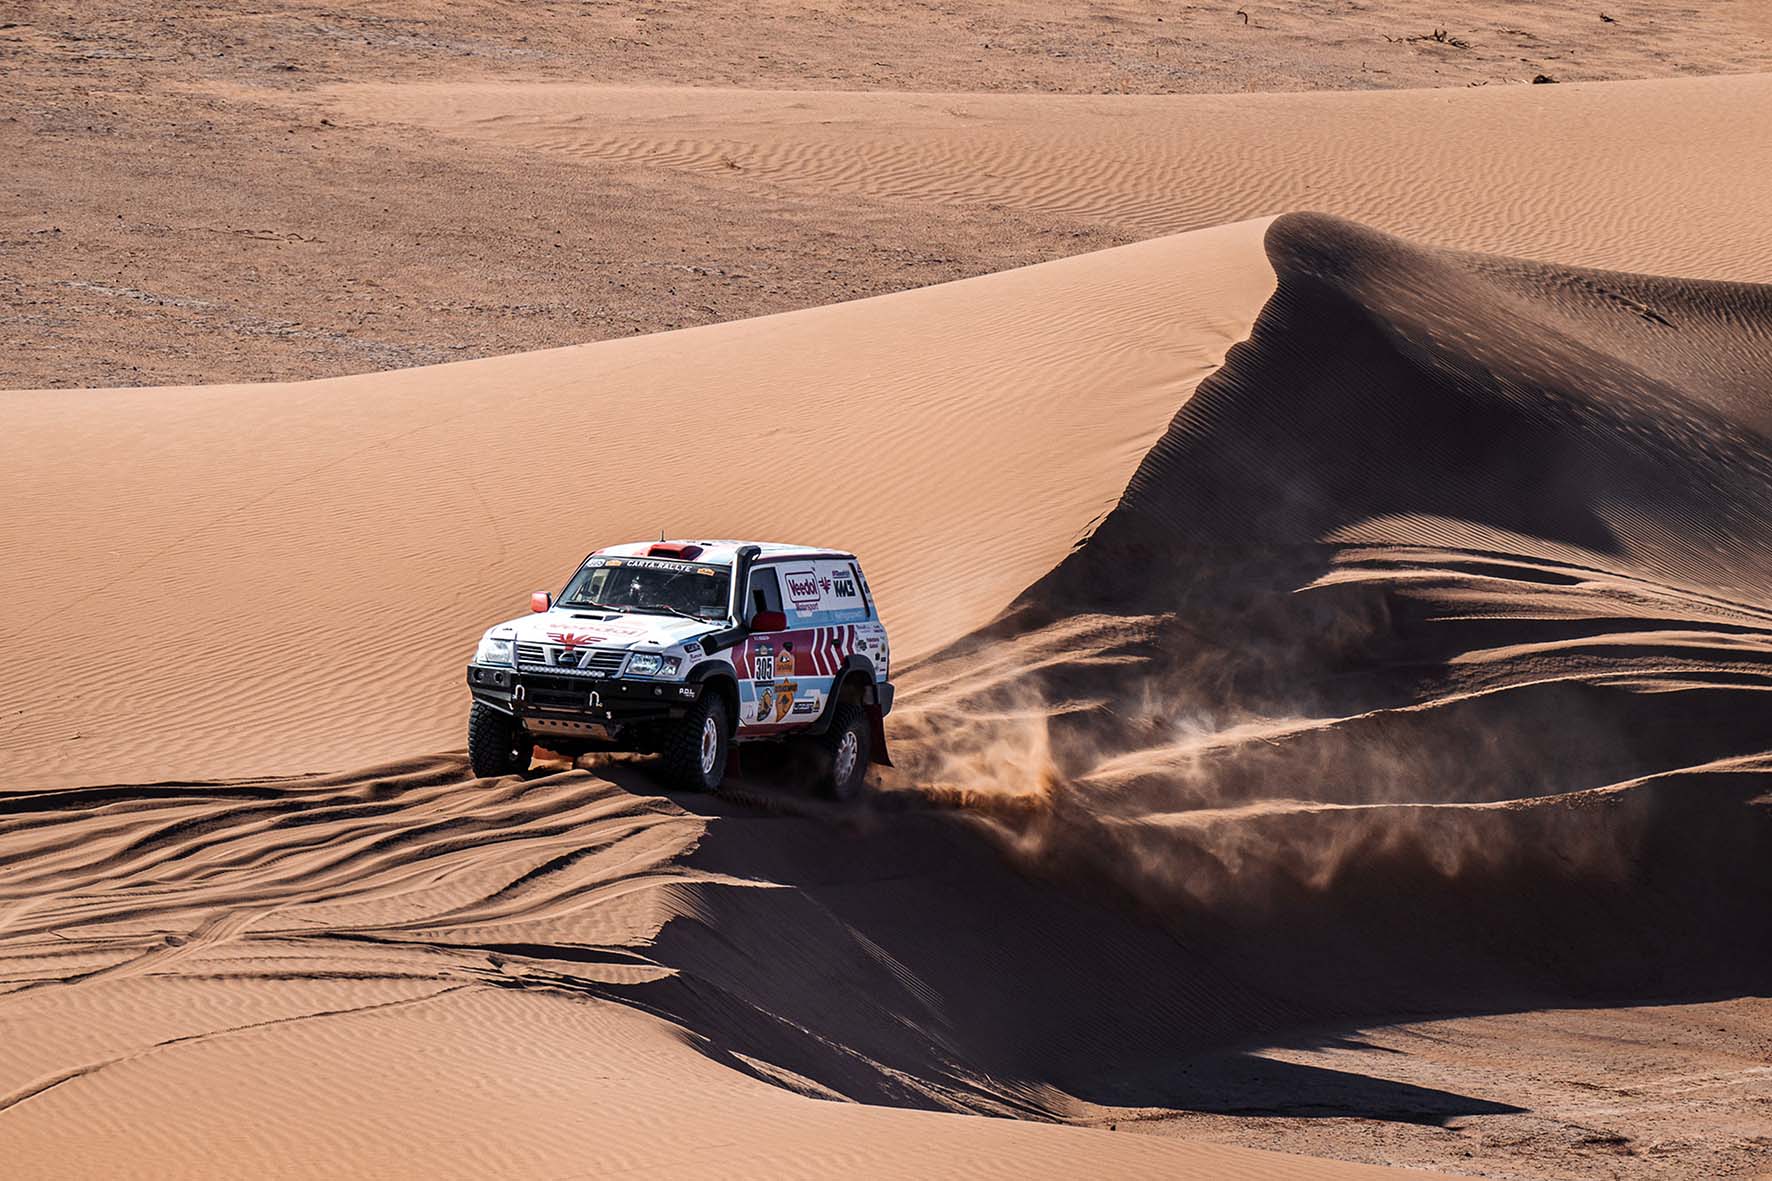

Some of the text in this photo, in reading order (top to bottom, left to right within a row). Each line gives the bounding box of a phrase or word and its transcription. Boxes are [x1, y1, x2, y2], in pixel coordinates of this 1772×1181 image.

[658, 562, 692, 572] RALLYE
[788, 579, 817, 596] Veedol
[756, 658, 772, 680] 305
